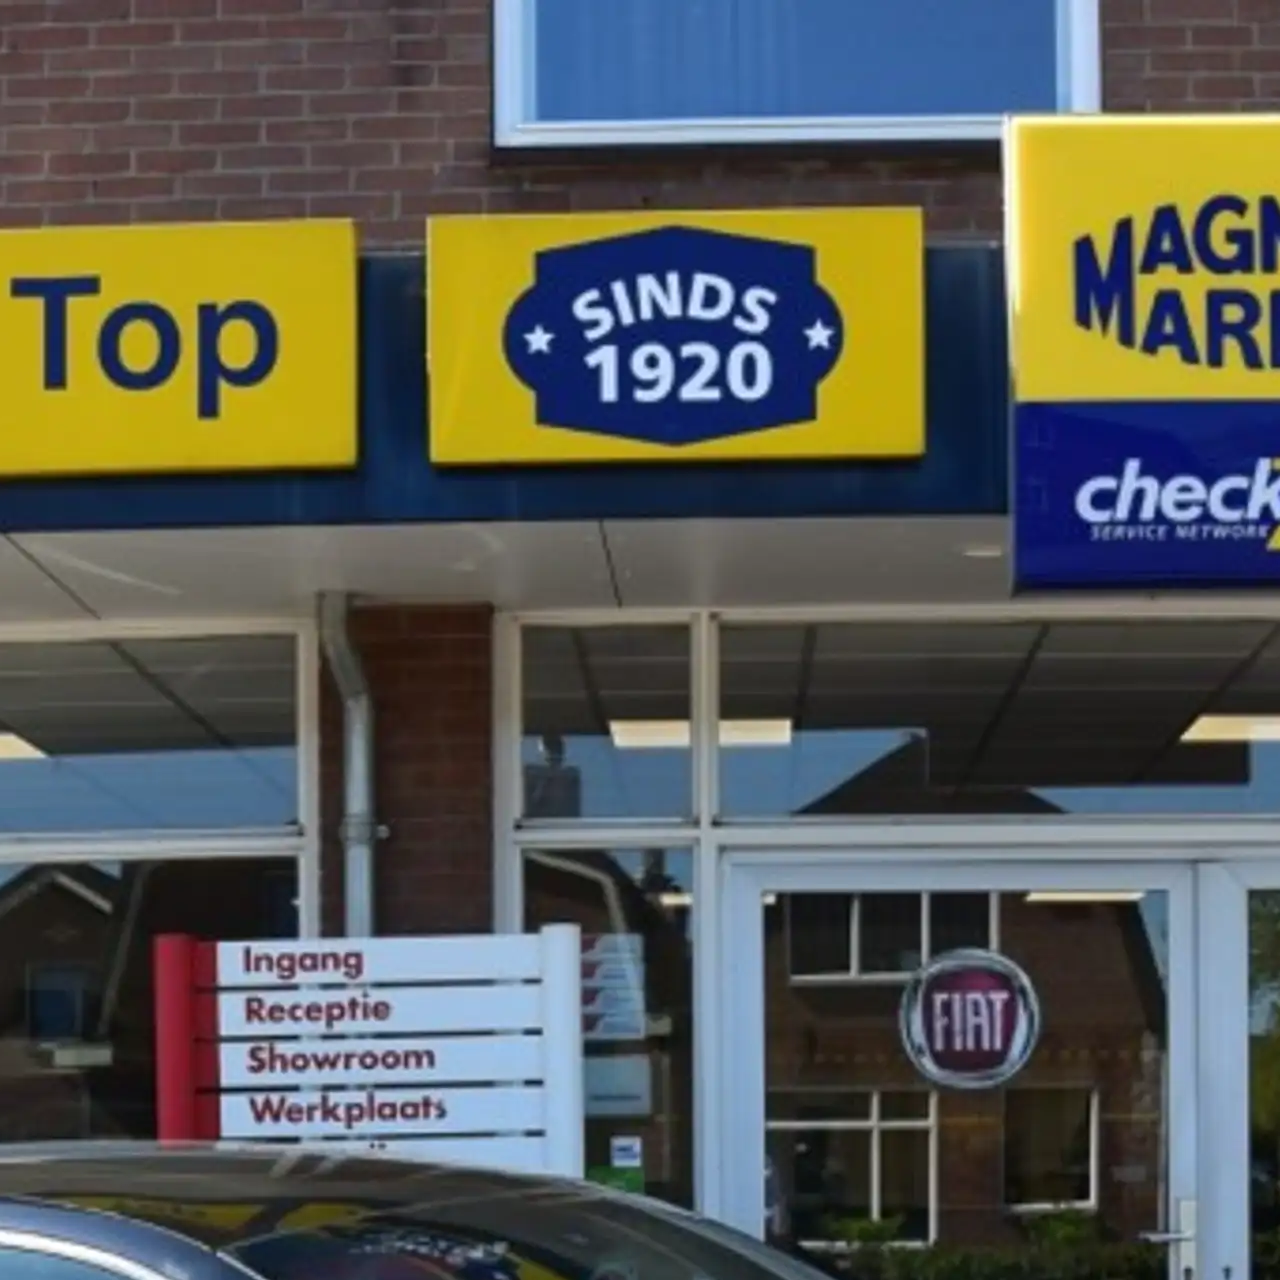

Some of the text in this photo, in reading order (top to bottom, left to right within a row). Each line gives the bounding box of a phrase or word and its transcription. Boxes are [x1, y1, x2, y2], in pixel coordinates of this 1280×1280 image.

[572, 270, 779, 341] SINDS
[9, 274, 280, 419] Top
[584, 341, 773, 403] 1920
[1089, 523, 1272, 542] SERVICE NETWORK
[241, 946, 365, 979] Ingang
[243, 991, 392, 1029] Receptie
[931, 990, 1011, 1053] FIAT
[246, 1041, 436, 1074] Showroom
[247, 1091, 448, 1130] Werkplaats
